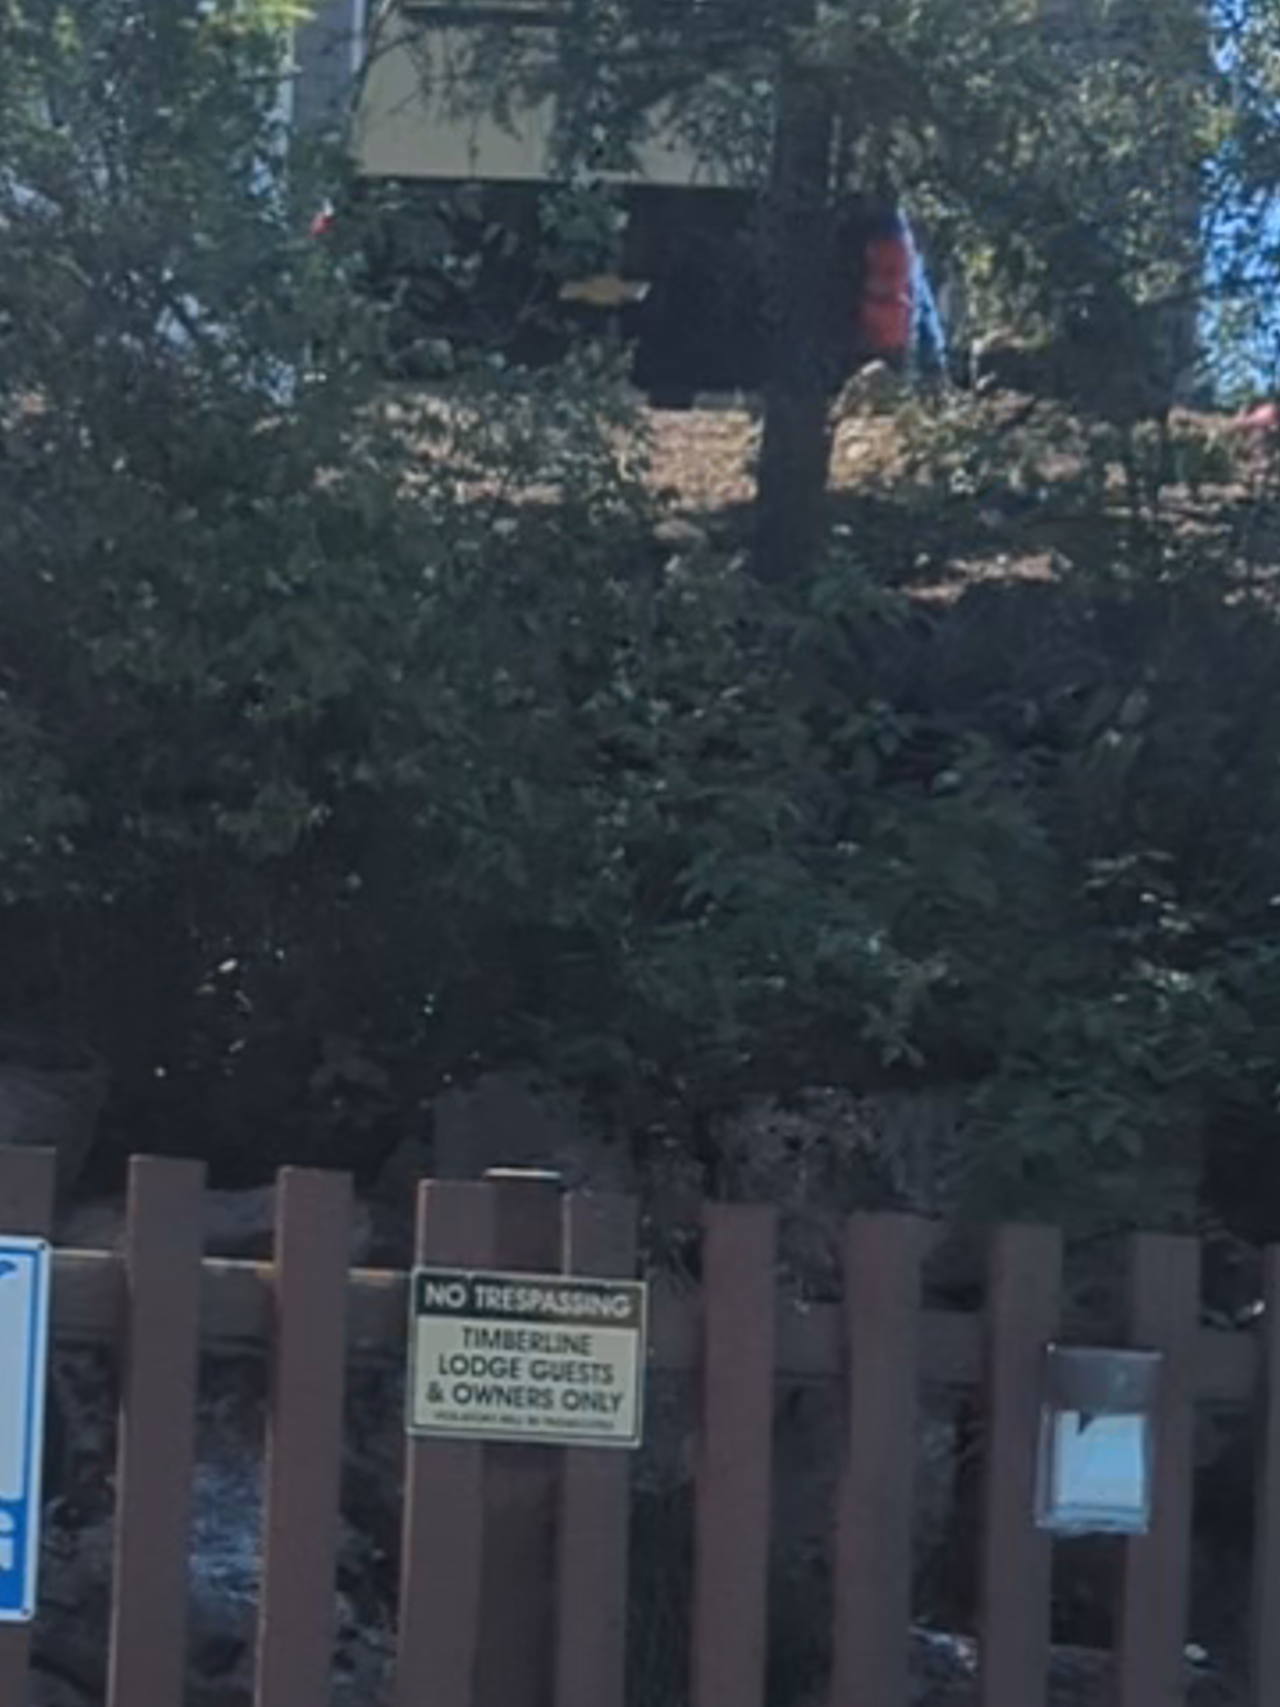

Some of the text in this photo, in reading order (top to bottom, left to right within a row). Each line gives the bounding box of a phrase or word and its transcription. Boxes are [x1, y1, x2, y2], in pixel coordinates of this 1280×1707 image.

[425, 1280, 633, 1319] NO TRESPASSING
[461, 1326, 594, 1357] TIMBERLINE
[438, 1354, 615, 1386] LODGE GUESTS
[426, 1380, 624, 1415] & OWNERS ONLY
